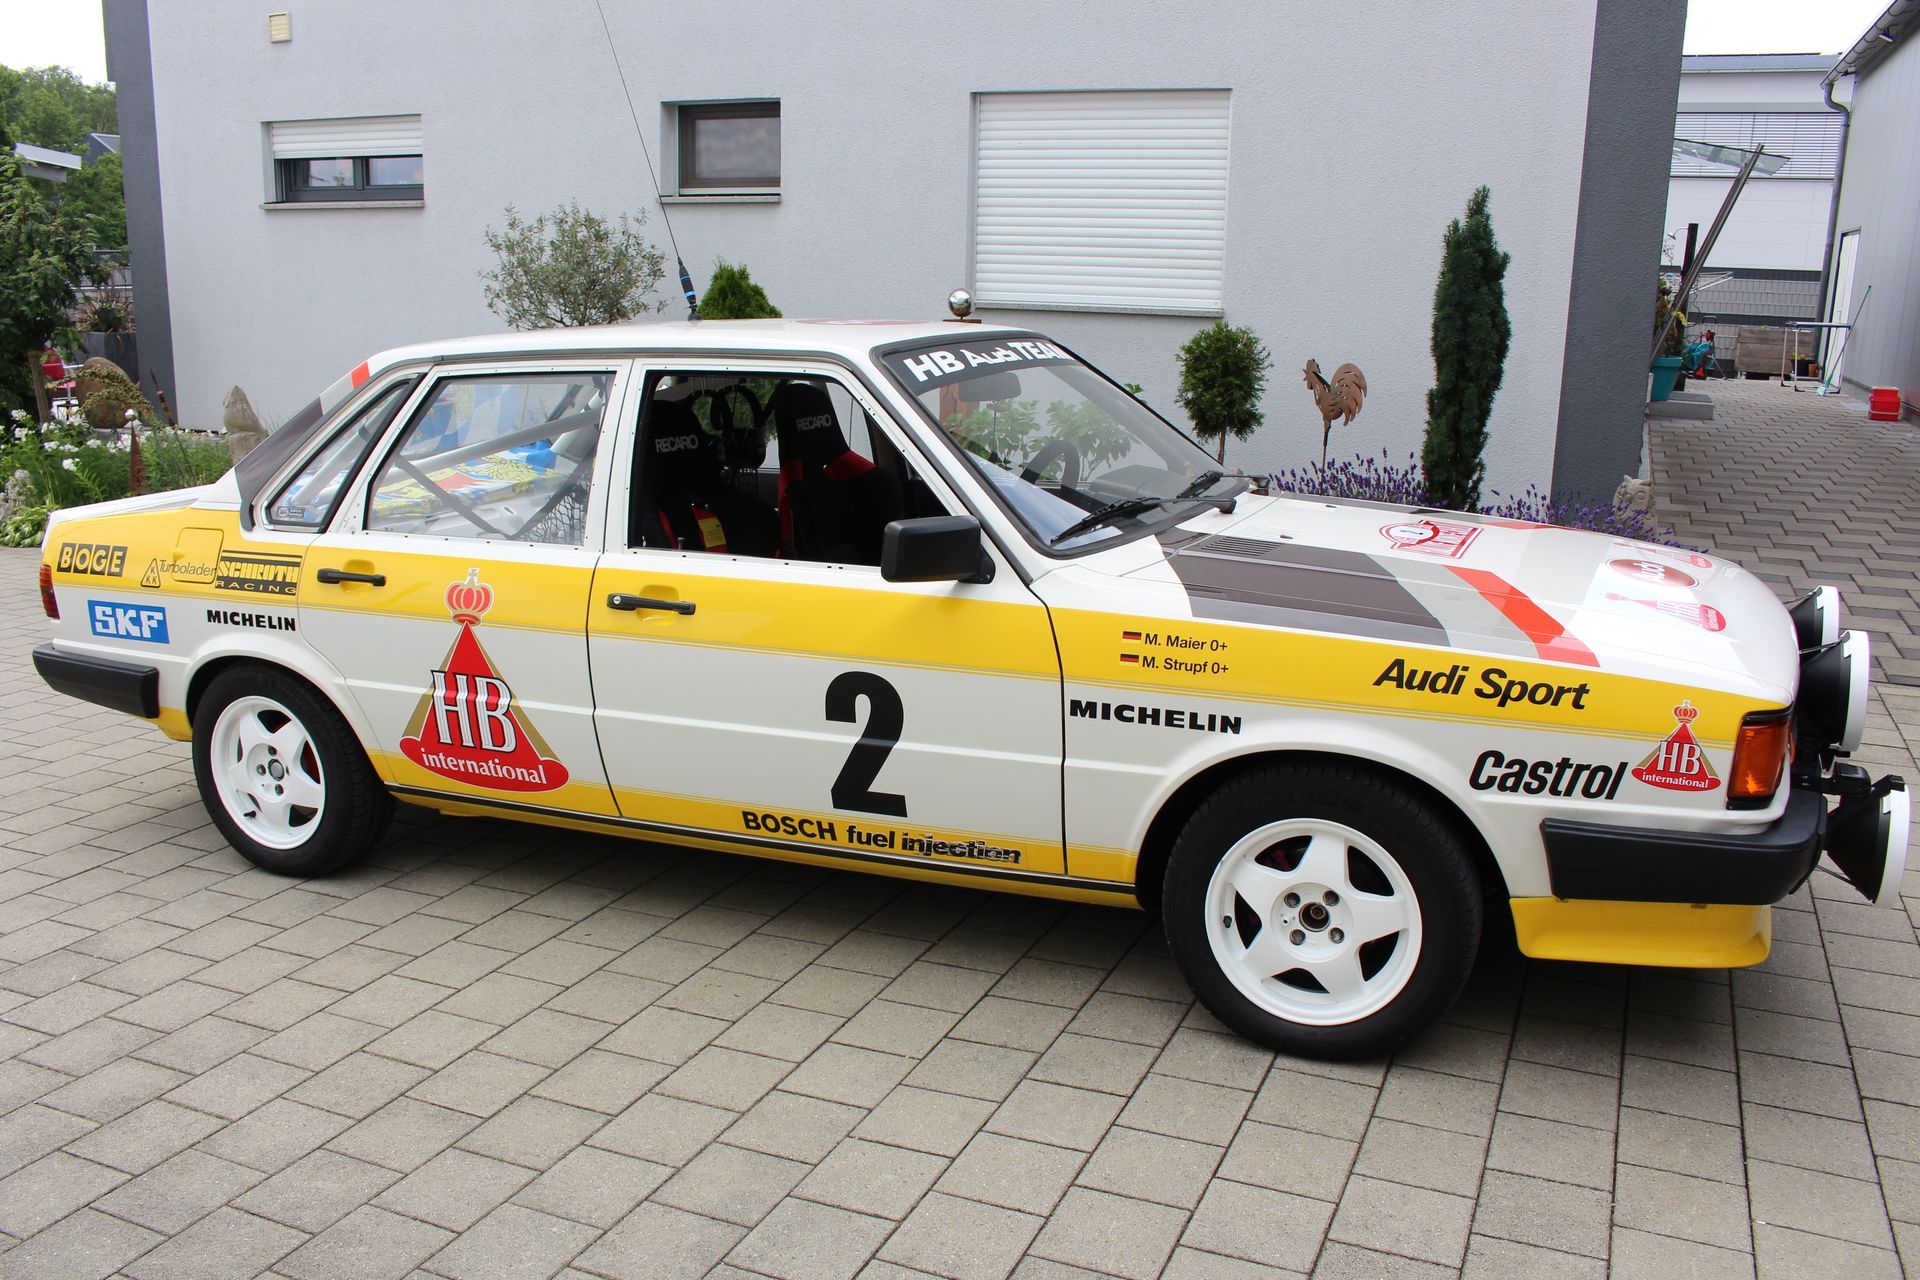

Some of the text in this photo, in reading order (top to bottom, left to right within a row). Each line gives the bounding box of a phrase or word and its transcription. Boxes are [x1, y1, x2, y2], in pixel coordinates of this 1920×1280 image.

[903, 350, 966, 382] HB
[959, 347, 1023, 368] Audi
[796, 414, 832, 431] RECARO
[655, 434, 698, 453] RECARO
[60, 546, 123, 573] BOGE
[159, 559, 217, 577] Turbolader
[217, 560, 300, 583] SCHROTH
[215, 580, 297, 594] RACING
[94, 605, 163, 638] SKF
[206, 609, 296, 632] MICHELIN
[1144, 633, 1161, 646] M.
[1166, 634, 1207, 651] Maier
[1142, 655, 1159, 669] M.
[1163, 657, 1208, 675] Strupf
[1372, 658, 1591, 710] Audi Sport
[431, 670, 517, 753] HB
[1070, 699, 1242, 735] MICHELIN
[825, 671, 908, 818] 2
[1656, 740, 1702, 776] HB
[421, 747, 548, 785] international
[1469, 750, 1629, 800] Castrol
[1642, 772, 1709, 789] international
[741, 811, 1022, 864] BOSCH fuel injection
